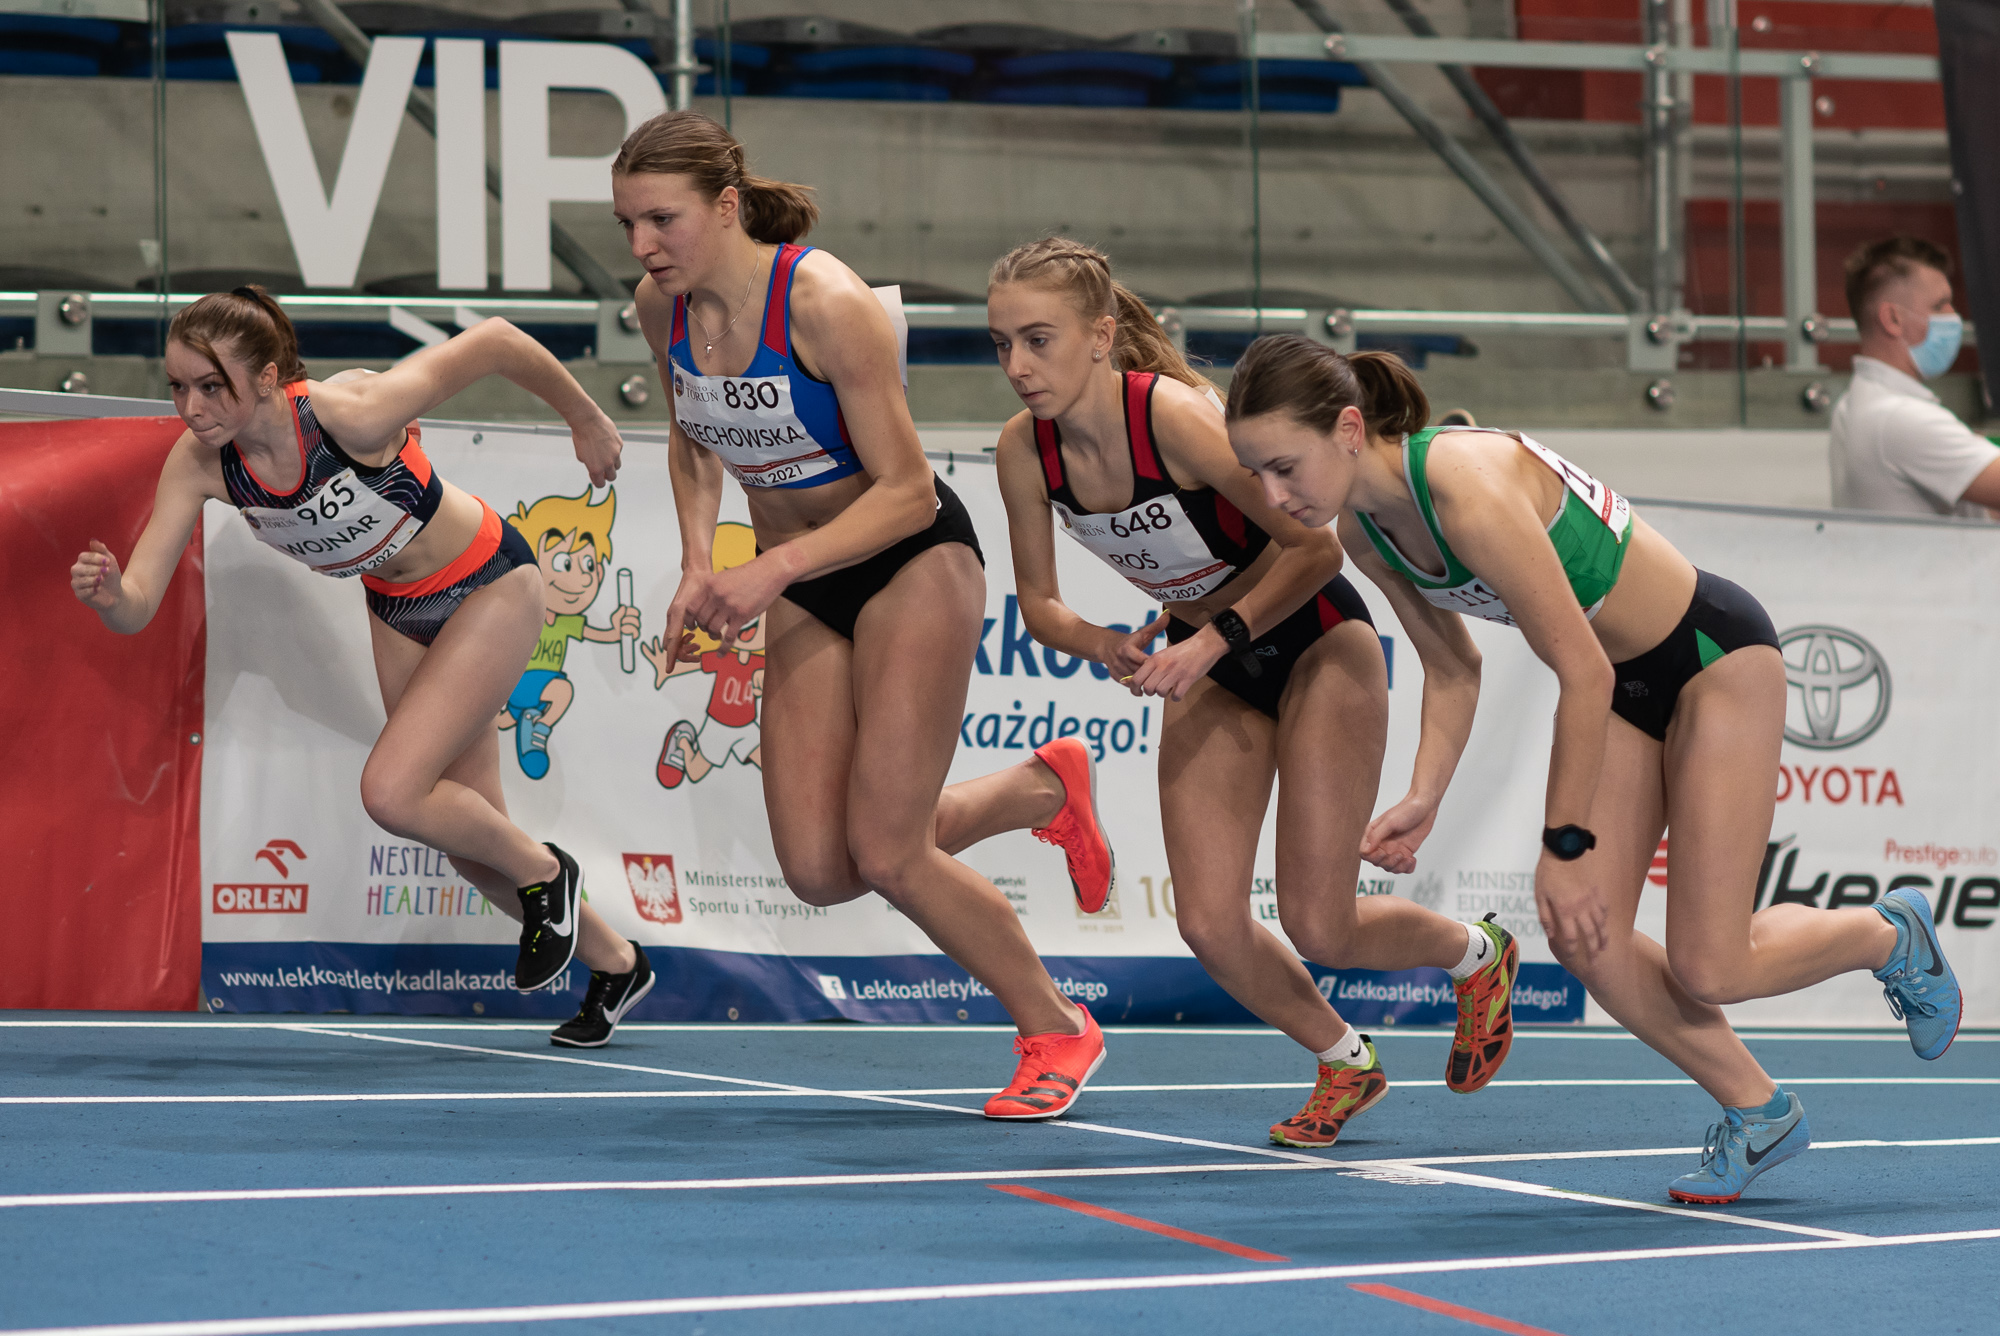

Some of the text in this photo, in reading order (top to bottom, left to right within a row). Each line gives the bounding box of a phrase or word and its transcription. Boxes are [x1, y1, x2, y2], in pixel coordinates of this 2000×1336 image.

[225, 32, 669, 291] VIP
[723, 380, 780, 410] 830
[680, 419, 806, 449] PIECHOWSKA
[767, 463, 804, 484] 2021
[296, 477, 355, 526] 965
[278, 514, 382, 557] WOJNAR
[1110, 502, 1172, 539] 648
[330, 563, 367, 579] ORUŃ
[367, 542, 398, 569] 2021
[1108, 548, 1160, 570] ROŚ
[1171, 583, 1207, 599] 2021
[722, 676, 754, 706] OLA
[1776, 764, 1905, 807] OYOTA
[685, 870, 788, 889] Ministerstwo
[217, 888, 303, 911] ORLEN
[689, 896, 828, 920] Sportu i Turystyki
[1457, 894, 1538, 914] EDUKAC
[220, 966, 571, 996] www.lekkoatletykadlakazde.pl
